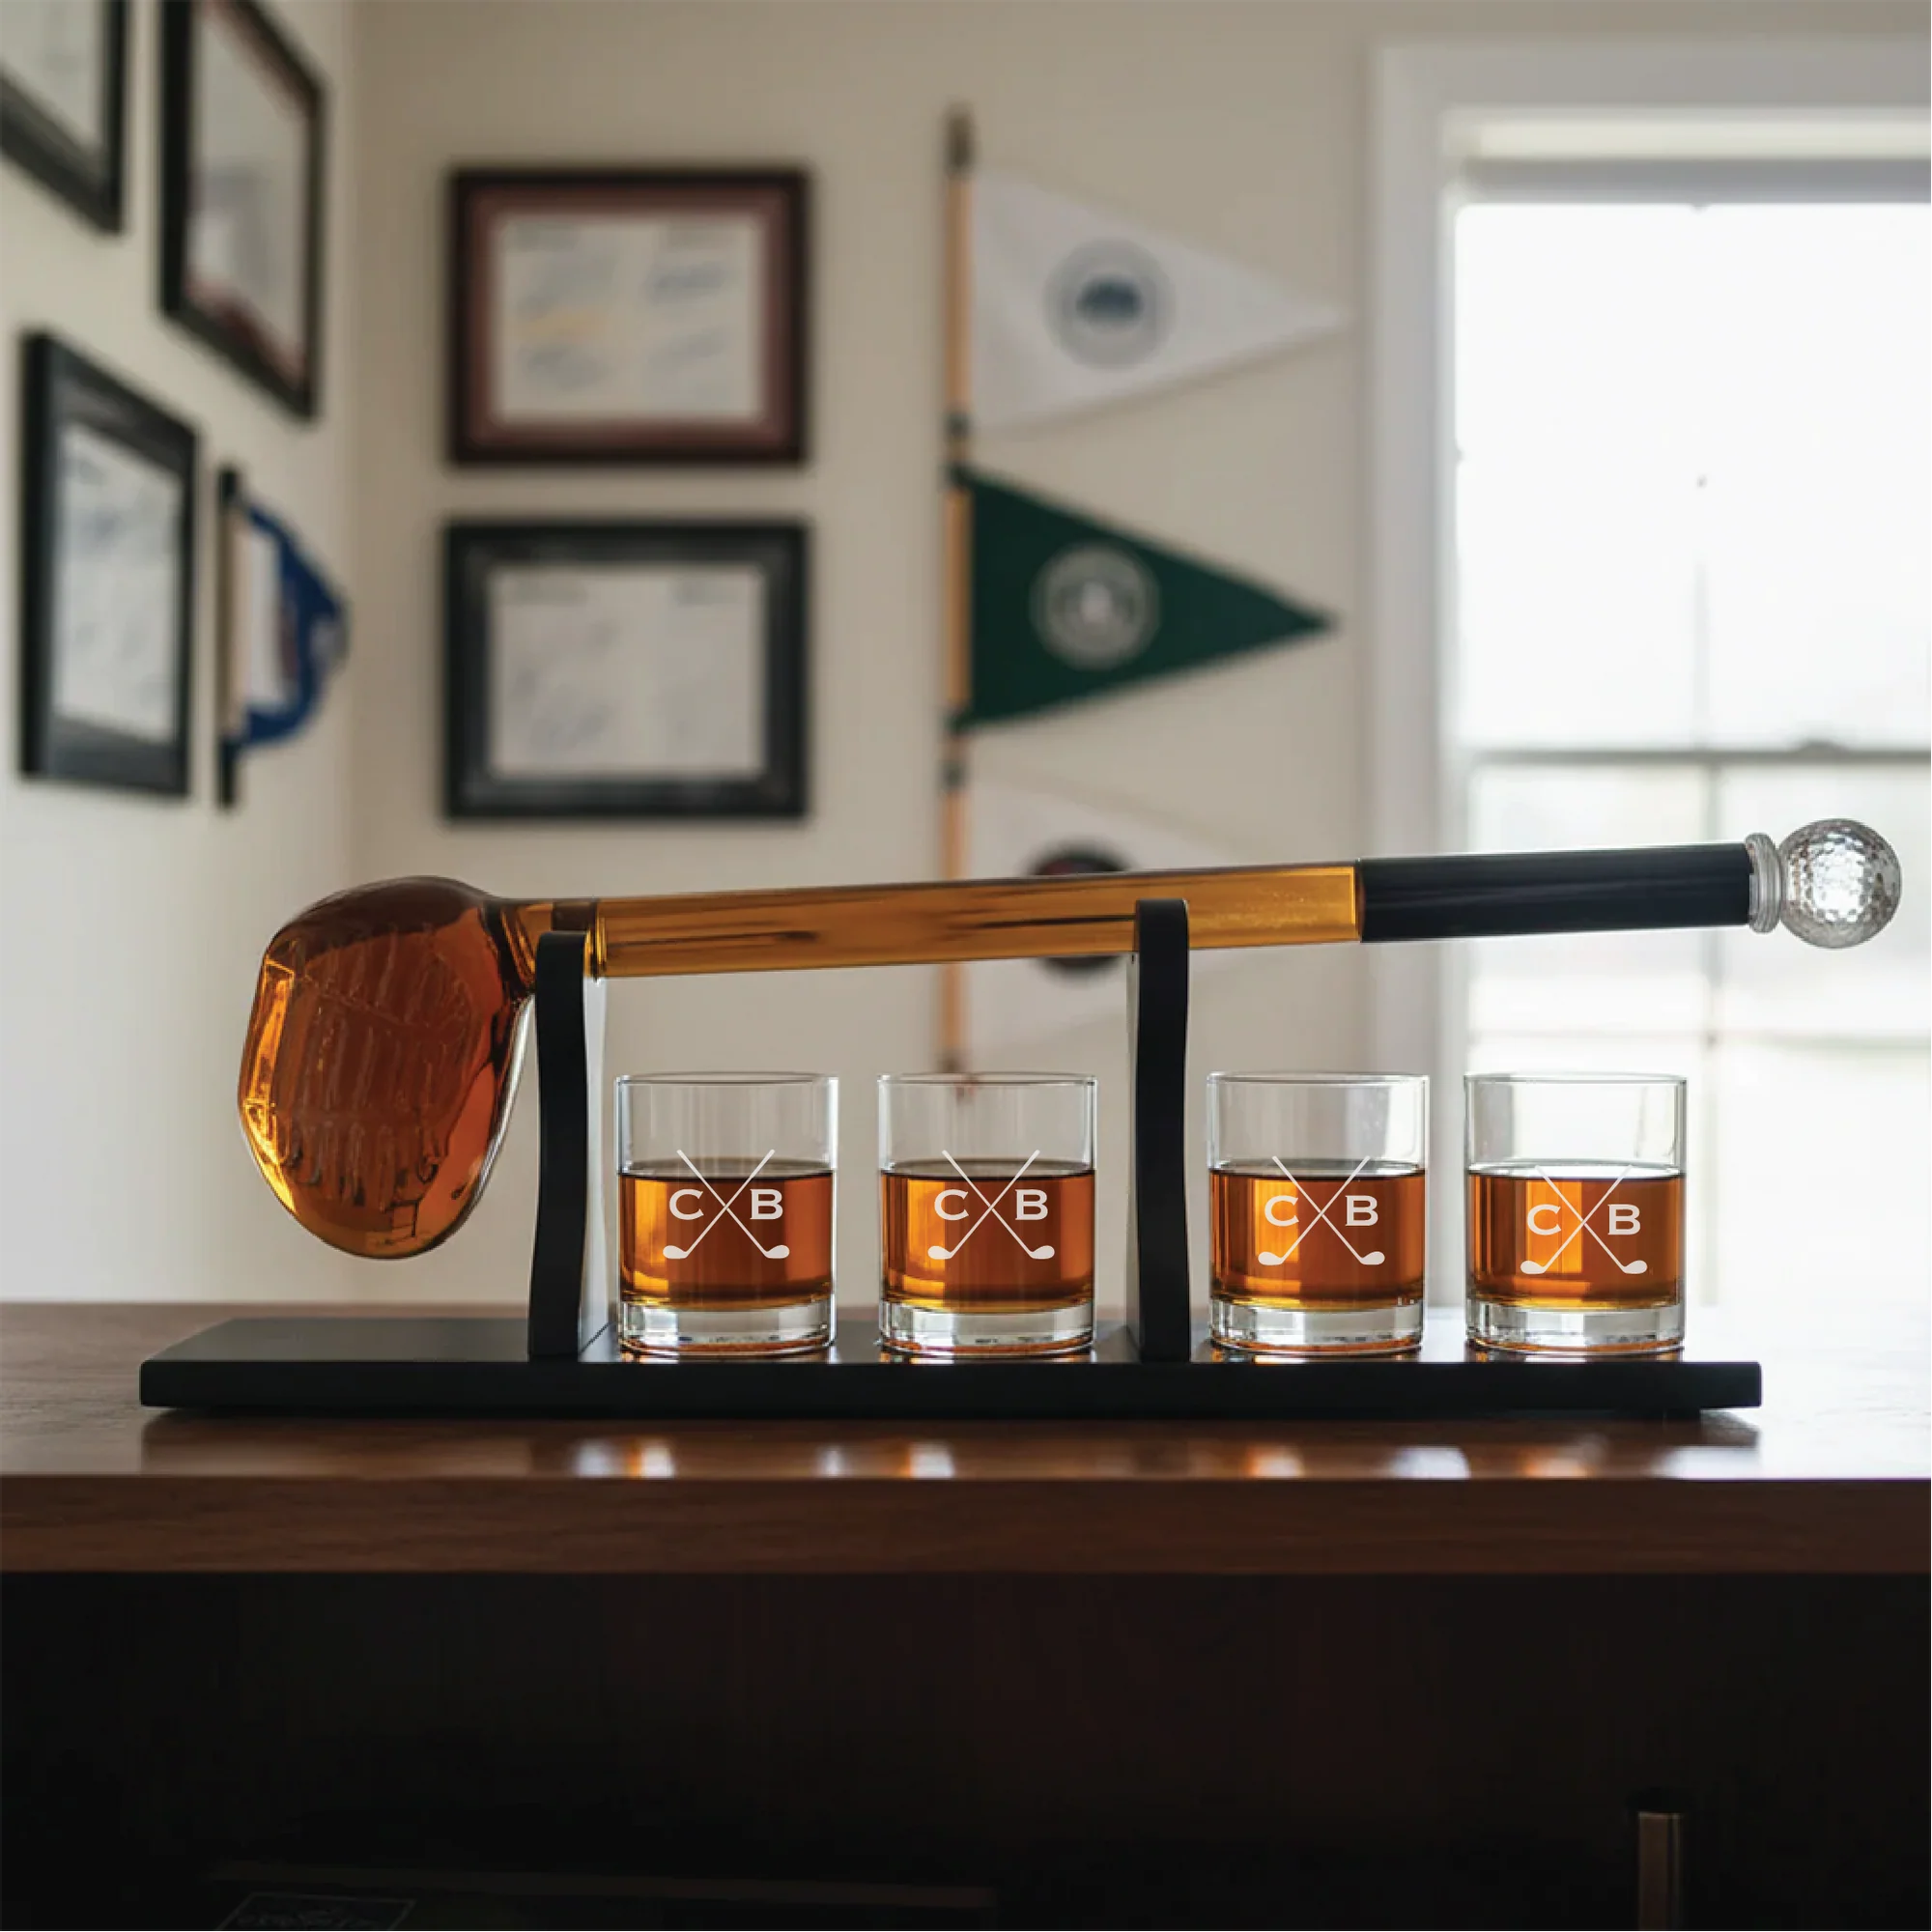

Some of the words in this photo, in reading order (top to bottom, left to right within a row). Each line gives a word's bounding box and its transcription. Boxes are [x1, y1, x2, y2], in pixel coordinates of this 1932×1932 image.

[668, 1188, 704, 1220] C
[750, 1188, 783, 1220] B
[934, 1188, 969, 1220] C
[1015, 1188, 1049, 1220] B
[1264, 1195, 1299, 1227] C
[1345, 1195, 1378, 1227] B
[1526, 1204, 1562, 1236] C
[1607, 1204, 1641, 1236] B
